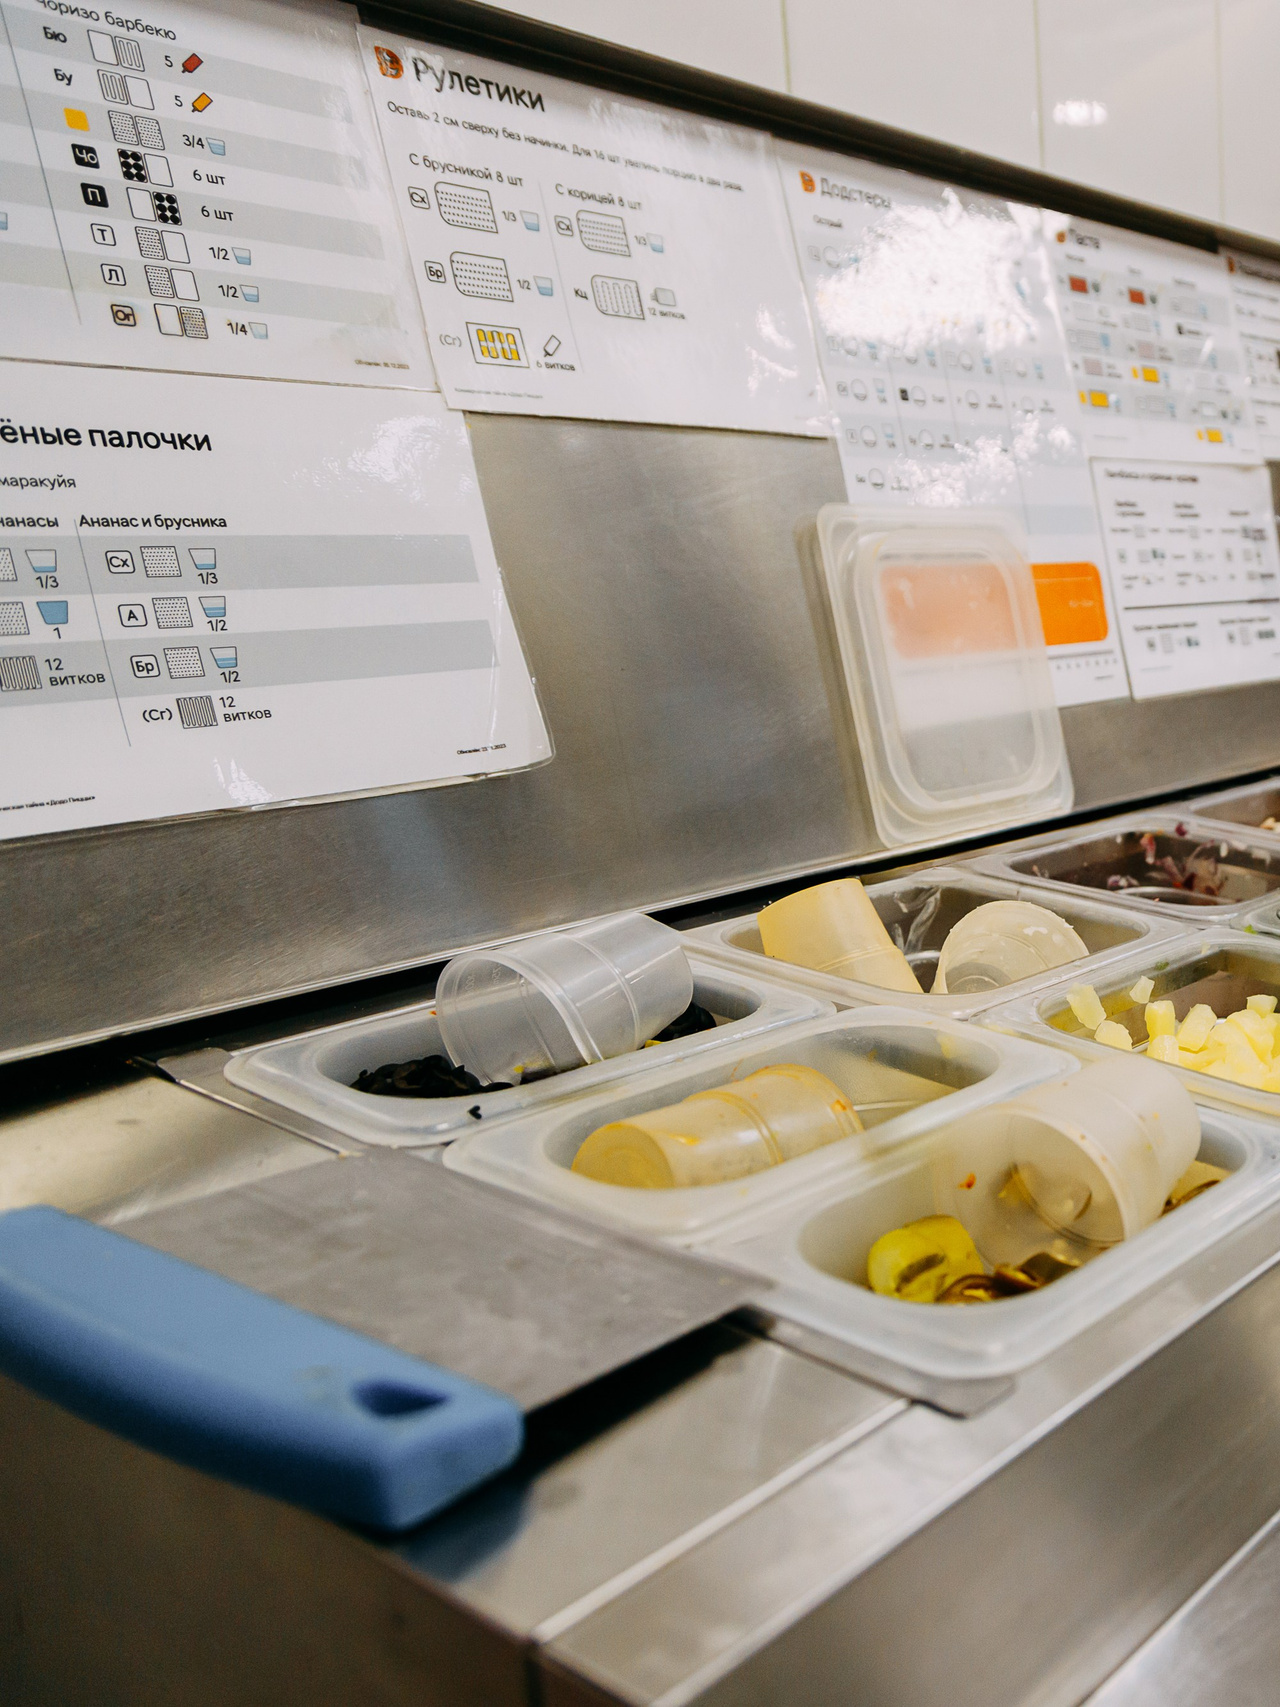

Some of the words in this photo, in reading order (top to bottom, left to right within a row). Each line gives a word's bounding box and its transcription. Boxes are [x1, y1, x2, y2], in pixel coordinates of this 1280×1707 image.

[104, 11, 177, 41] барбекю
[43, 26, 68, 43] Бю
[164, 55, 173, 68] 5
[54, 68, 73, 86] Бу
[411, 57, 545, 112] Рулетики
[175, 96, 183, 108] 5
[387, 101, 430, 121] Оставь
[433, 112, 441, 123] 2
[443, 116, 459, 128] см
[462, 120, 499, 138] сверху
[502, 128, 521, 142] без
[182, 134, 205, 149] 3/4
[76, 148, 98, 164] Чо
[409, 153, 420, 166] С
[422, 155, 493, 181] брусникой
[496, 171, 504, 183] 8
[507, 174, 523, 187] шт
[193, 169, 202, 182] 6
[206, 173, 226, 186] шт
[87, 188, 102, 203] П
[555, 183, 564, 195] С
[567, 187, 615, 206] корицей
[627, 200, 642, 210] шт
[201, 205, 210, 218] 6
[214, 209, 234, 222] шт
[502, 210, 517, 222] 1/3
[97, 228, 108, 242] Т
[634, 235, 647, 246] 1/3
[209, 246, 230, 261] 1/2
[108, 268, 120, 282] Л
[428, 266, 443, 280] Бр
[218, 284, 239, 299] 1/2
[517, 279, 531, 290] 1/2
[115, 309, 132, 323] Ог
[227, 322, 248, 336] 1/4
[439, 333, 462, 348] (Сг)
[544, 361, 576, 372] витков
[0, 418, 83, 446] ёные
[88, 428, 212, 451] палочки
[79, 514, 139, 528] Ананас
[142, 516, 151, 528] и
[154, 514, 227, 530] брусника
[109, 556, 130, 568] Сх
[36, 575, 59, 589] 1/3
[198, 572, 218, 585] 1/3
[127, 610, 138, 622] А
[207, 619, 228, 632] 1/2
[53, 627, 62, 639] 1
[45, 658, 64, 671] 12
[135, 661, 154, 675] Бр
[49, 673, 106, 686] витков
[220, 671, 241, 684] 1/2
[219, 696, 236, 708] 12
[142, 708, 173, 723] (Сг)
[223, 709, 272, 723] витков
